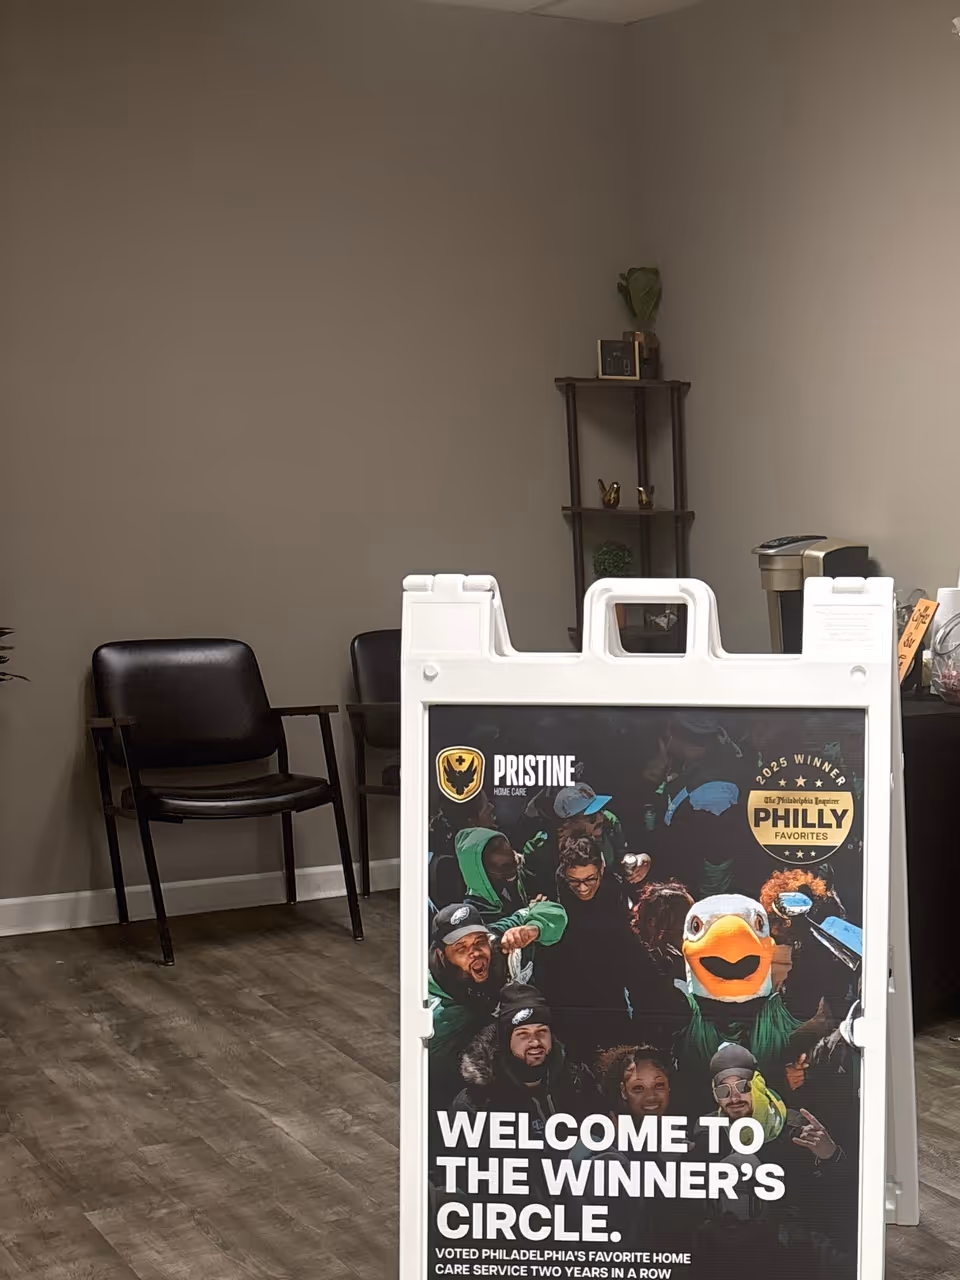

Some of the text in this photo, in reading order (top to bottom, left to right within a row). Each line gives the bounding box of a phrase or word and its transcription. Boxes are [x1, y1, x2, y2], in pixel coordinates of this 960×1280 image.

[493, 754, 576, 787] PRISTINE
[755, 753, 847, 787] 2025 WINNER
[493, 787, 527, 797] HOME CARE
[763, 796, 840, 806] The Philadelphia Inquirer
[753, 807, 850, 829] PHILLY
[774, 831, 829, 840] FAVORITES
[436, 1110, 765, 1155] WELCOME TO
[436, 1156, 786, 1201] THE WINNER'S
[436, 1202, 623, 1243] CIRCLE.
[435, 1247, 692, 1264] VOTED PHILADELPHIA'S FAVORITE HOME
[435, 1264, 672, 1280] CARE SERVICE TWO YEARS IN A ROW
